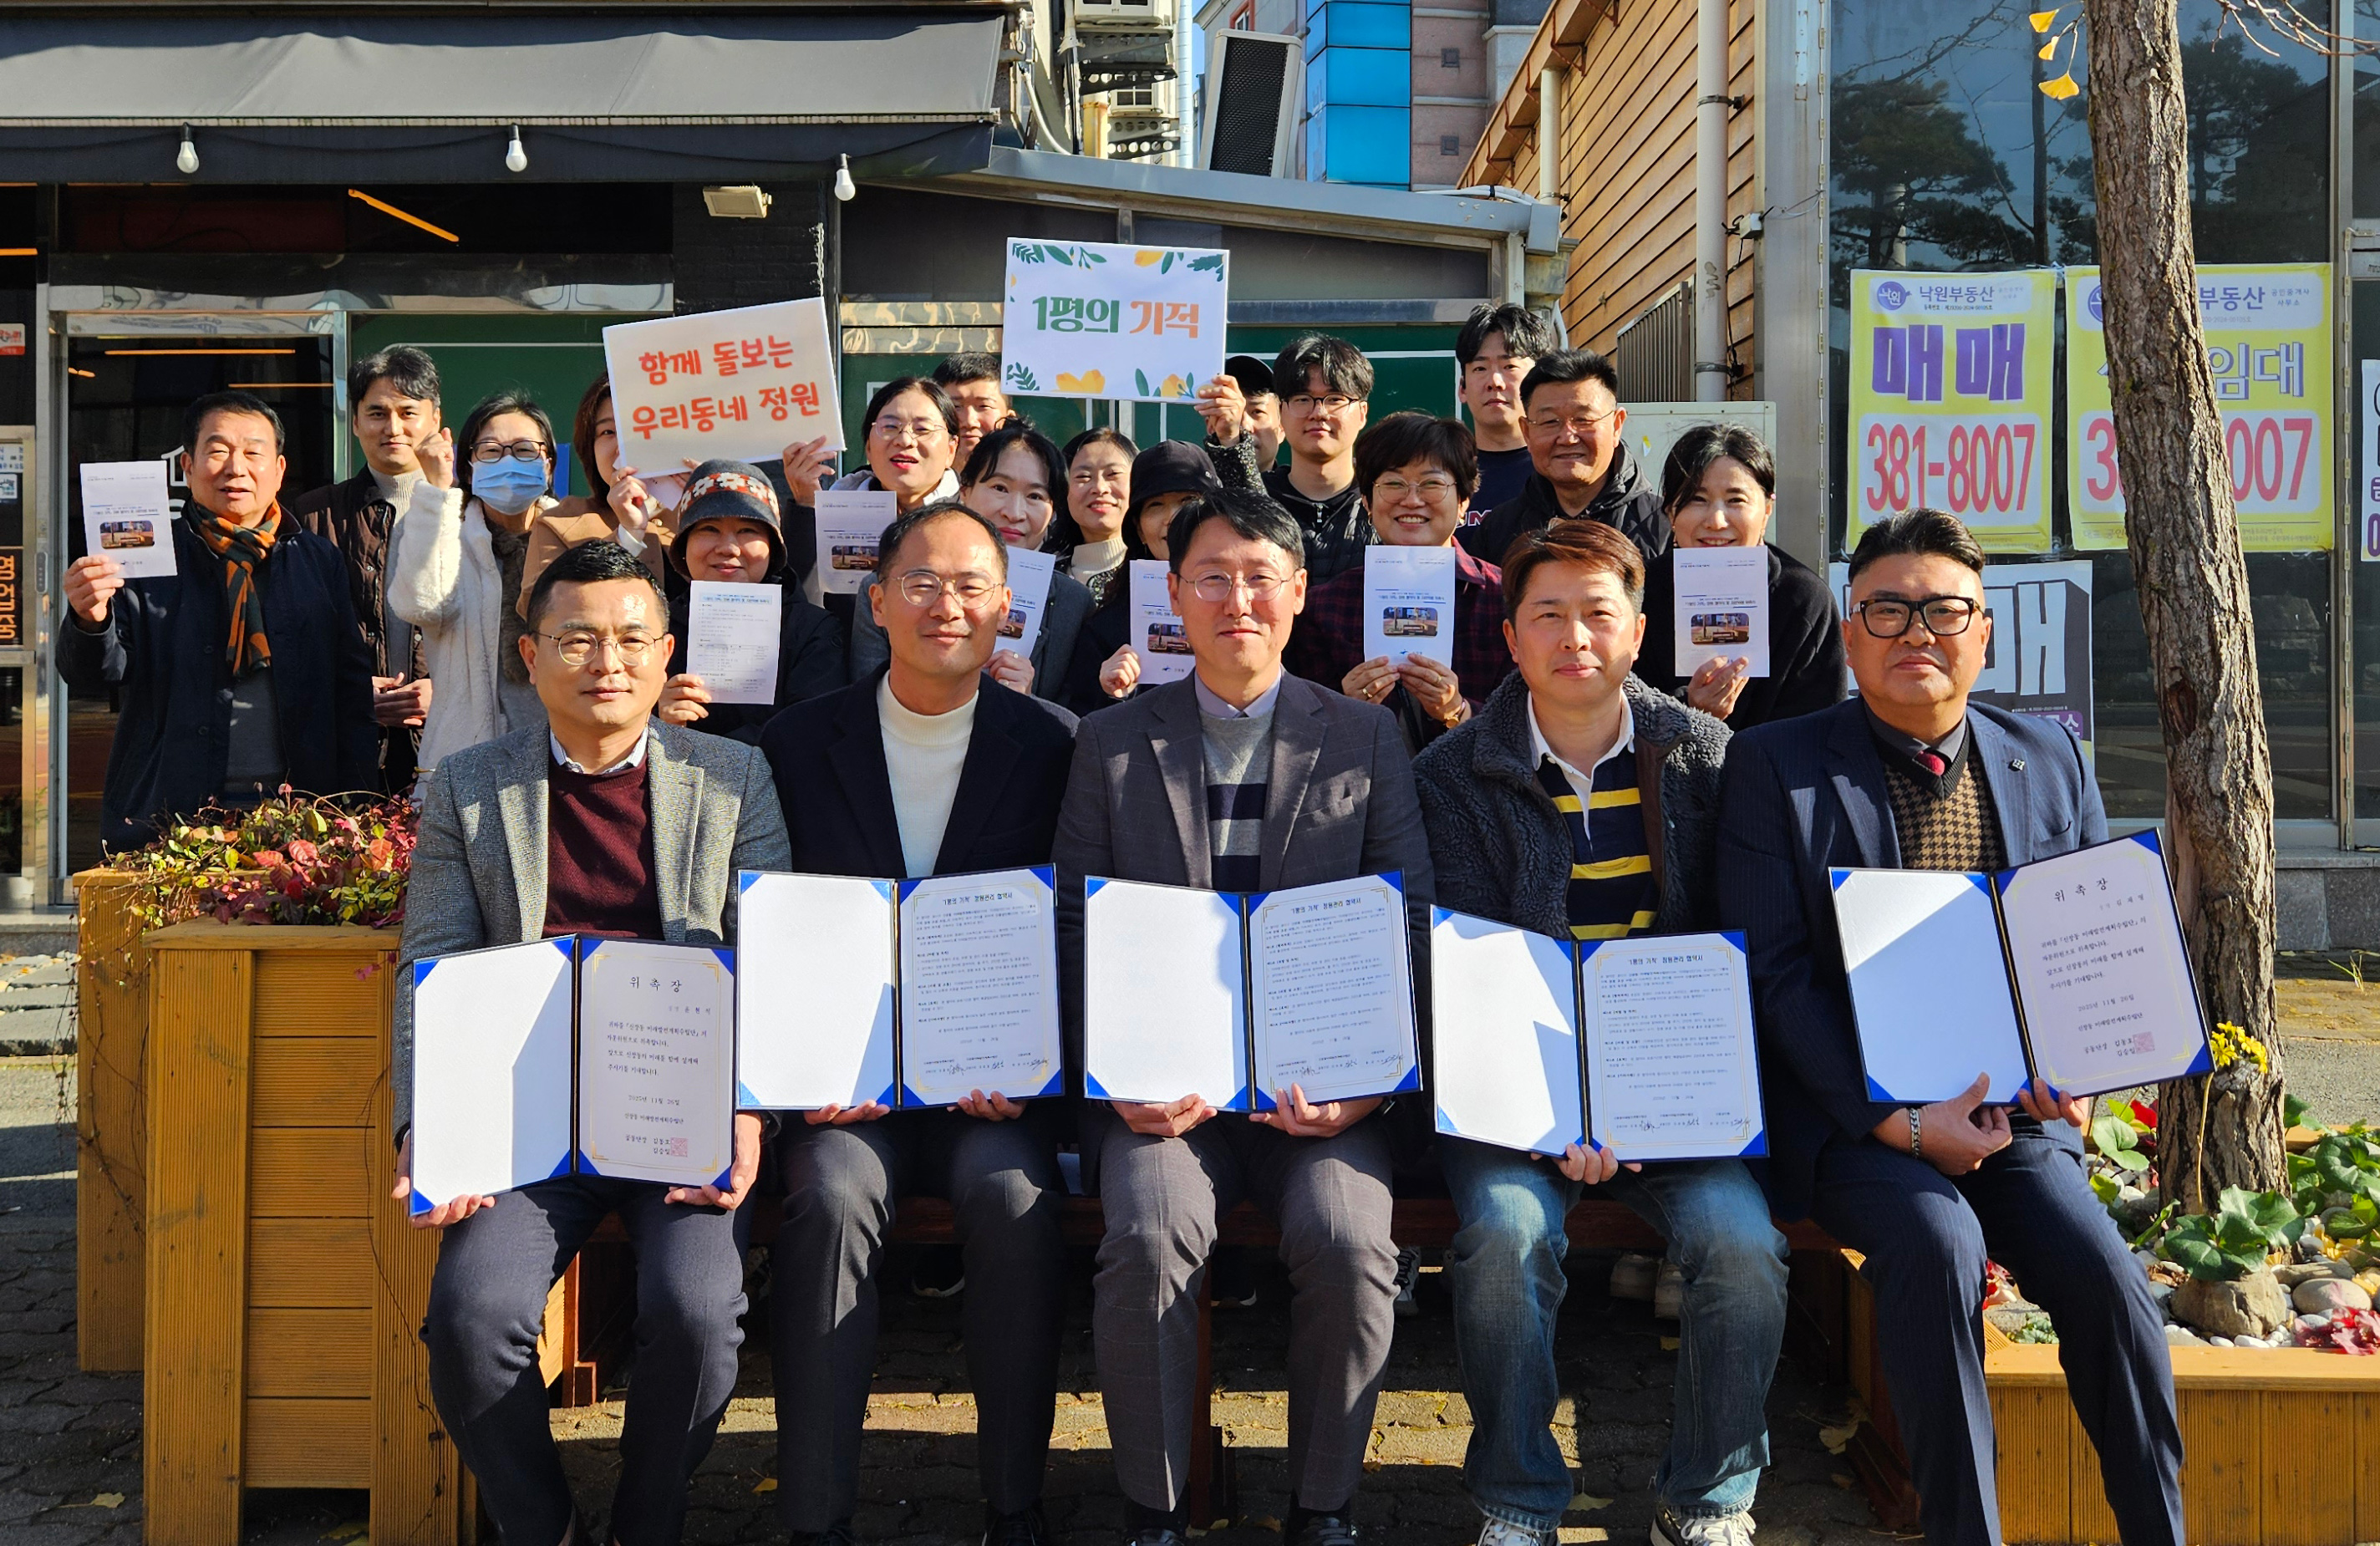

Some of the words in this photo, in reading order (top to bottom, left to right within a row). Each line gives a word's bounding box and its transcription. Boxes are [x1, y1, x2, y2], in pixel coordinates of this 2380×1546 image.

[1032, 296, 1120, 333] 1평의
[1129, 301, 1199, 338] 기적
[1920, 286, 1995, 303] 낙원부동산
[2199, 286, 2266, 312] 부동산
[638, 348, 702, 385] 함께
[713, 334, 793, 377] 돌보는
[633, 395, 748, 440] 우리동네
[759, 381, 820, 421] 정원
[1866, 423, 2035, 512] 381-8007
[2087, 418, 2312, 501] 3007
